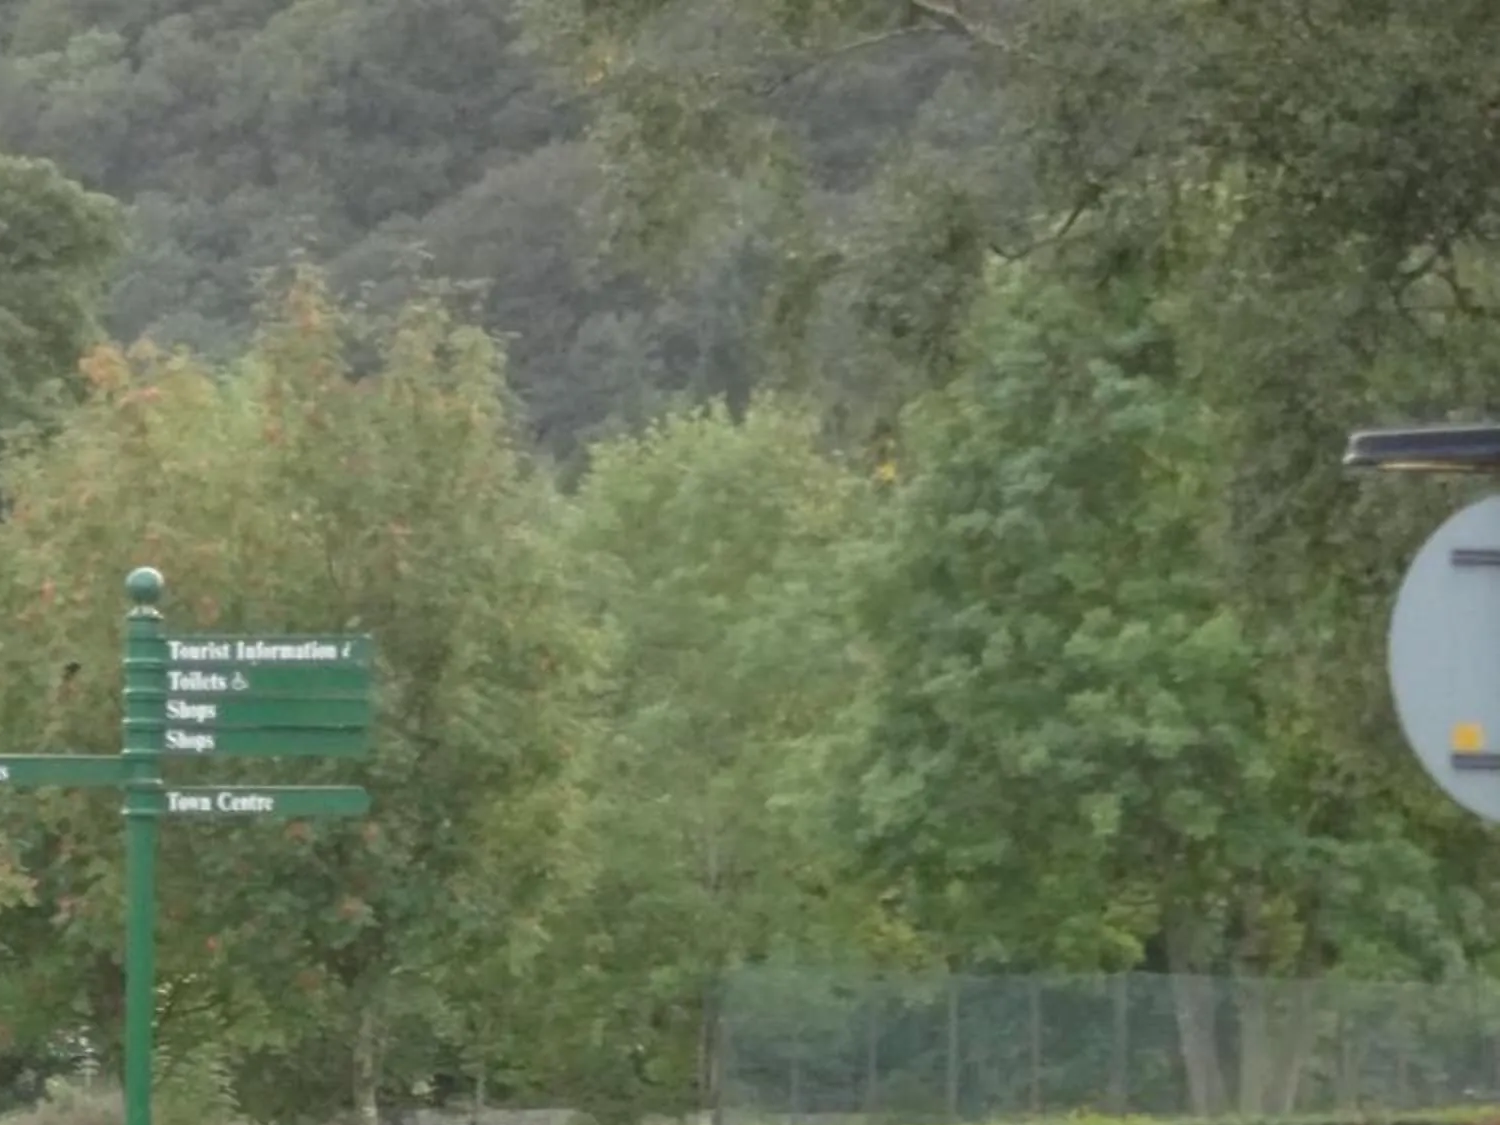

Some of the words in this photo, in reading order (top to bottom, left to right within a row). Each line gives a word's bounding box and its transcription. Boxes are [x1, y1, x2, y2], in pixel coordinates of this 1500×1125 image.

[167, 640, 230, 661] Tourist
[236, 640, 338, 662] Information
[167, 670, 228, 691] Toilets
[166, 700, 217, 723] Shops
[165, 729, 216, 753] Shops
[166, 791, 212, 811] Town
[217, 791, 274, 812] Centre
